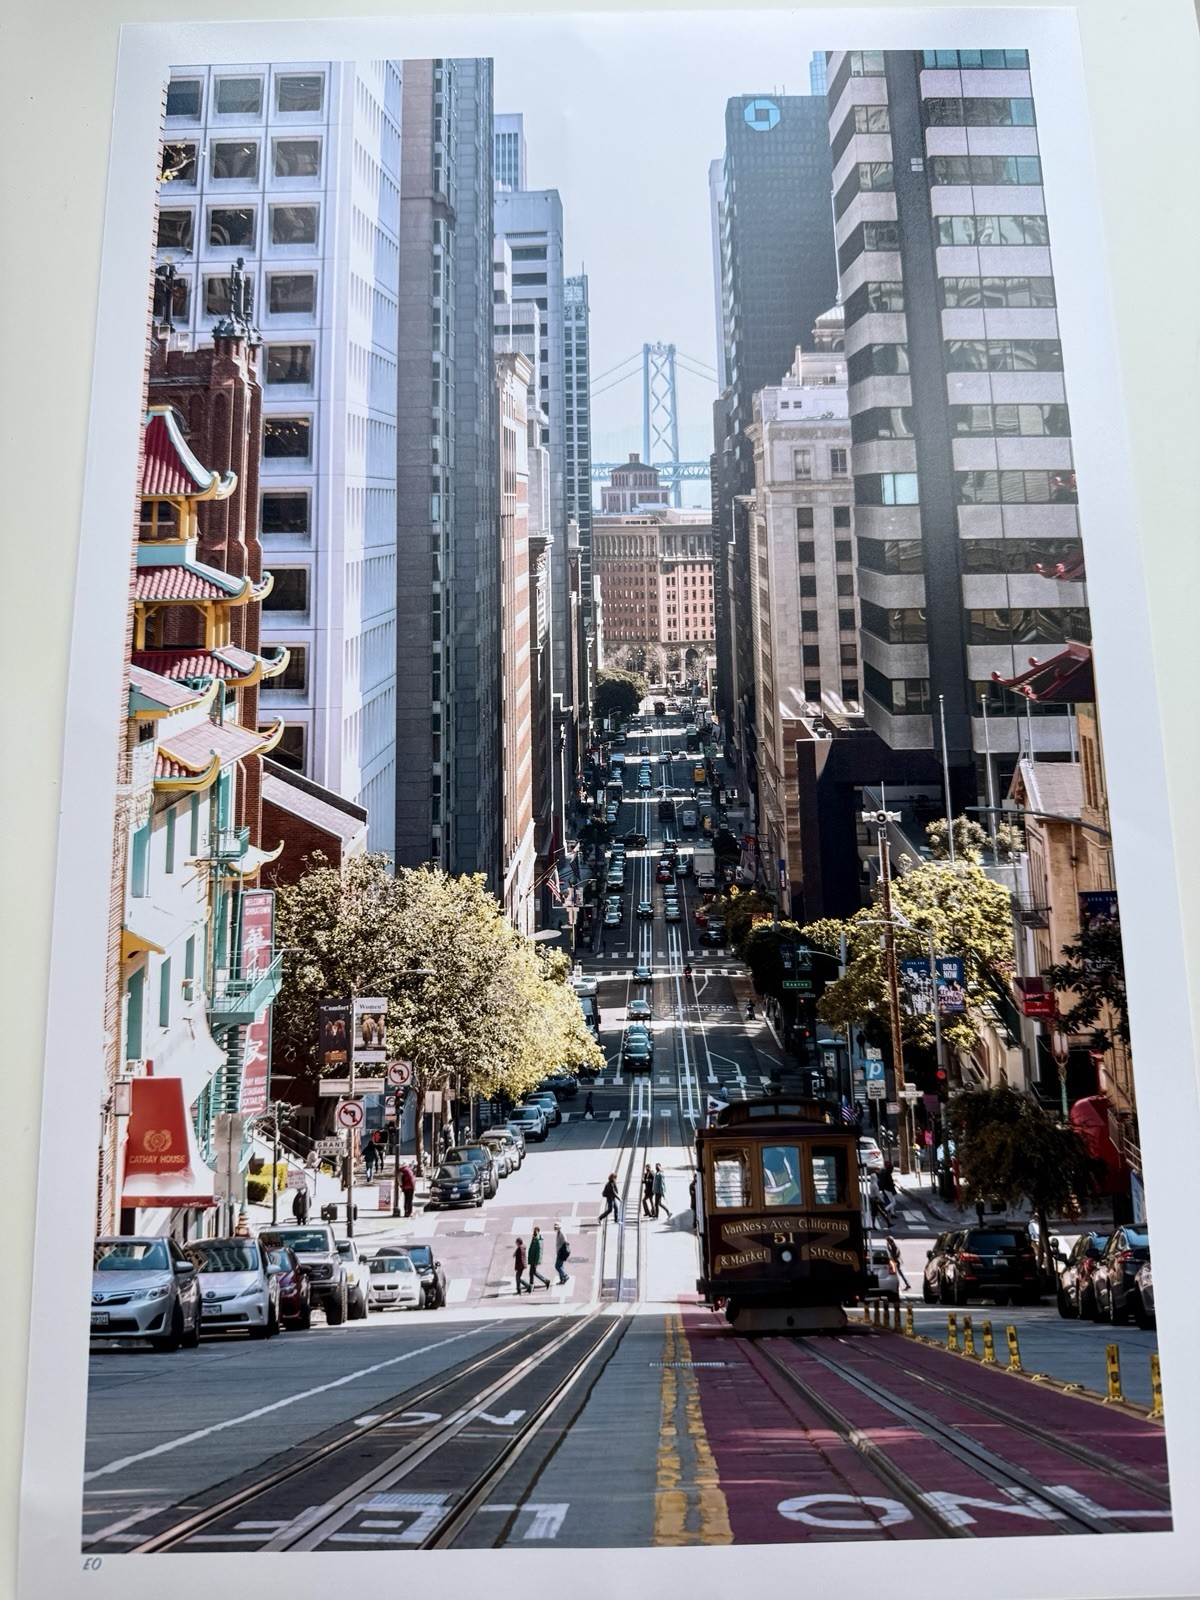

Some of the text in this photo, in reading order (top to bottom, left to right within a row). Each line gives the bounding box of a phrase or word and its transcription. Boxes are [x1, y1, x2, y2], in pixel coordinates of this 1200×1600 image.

[129, 1154, 186, 1163] CATHAY HOUSE
[724, 1225, 741, 1235] Van
[742, 1220, 767, 1232] Ness
[798, 1218, 849, 1231] California
[773, 1232, 795, 1244] 51
[720, 1246, 852, 1266] & Market Streets
